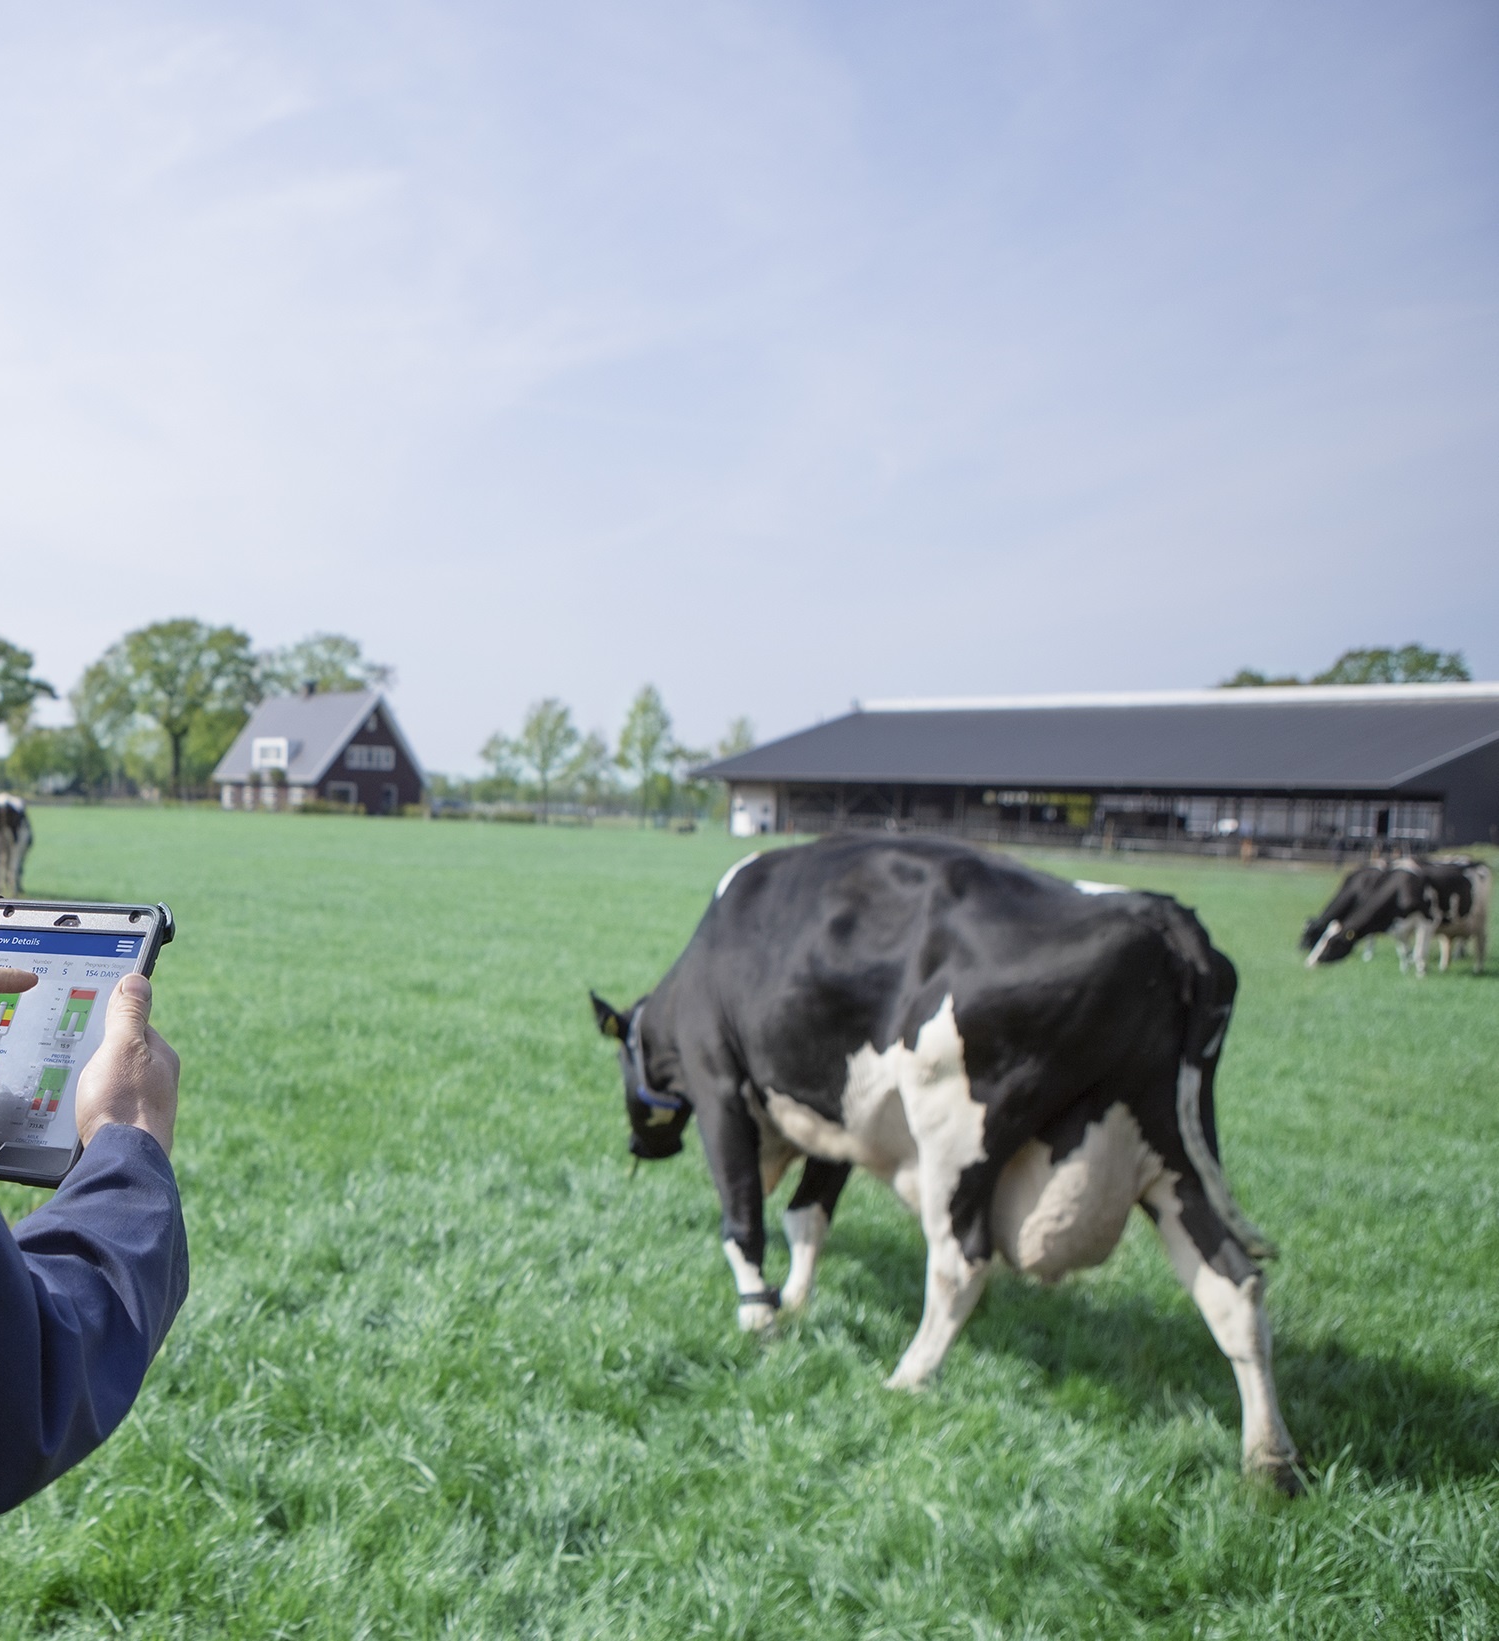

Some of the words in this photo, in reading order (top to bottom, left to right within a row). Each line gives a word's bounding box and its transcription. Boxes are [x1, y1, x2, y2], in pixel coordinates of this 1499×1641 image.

[11, 937, 41, 946] Details
[31, 966, 49, 974] 1193
[100, 970, 120, 978] DAYS
[43, 1057, 76, 1065] CONCENTRATE
